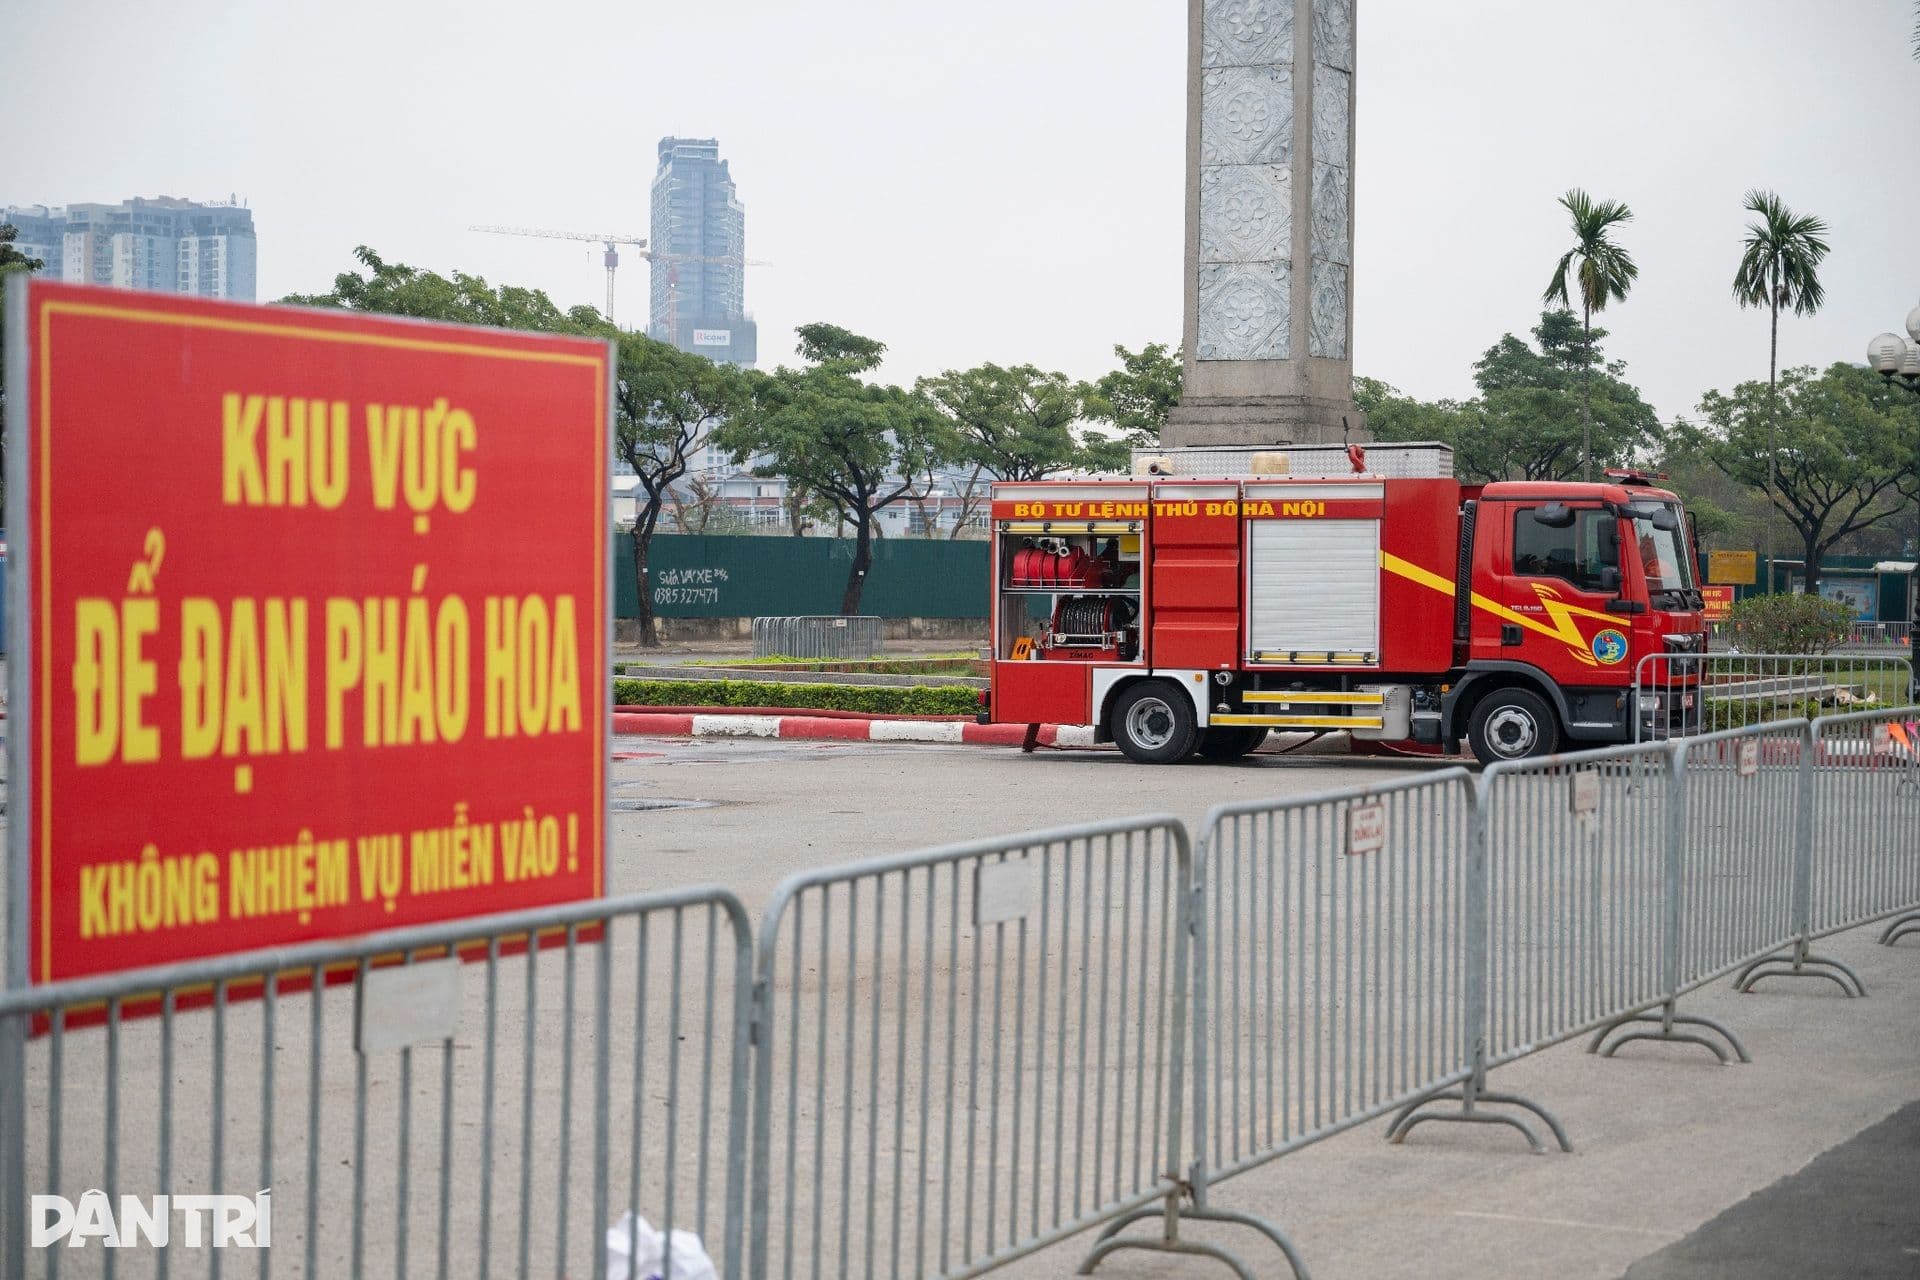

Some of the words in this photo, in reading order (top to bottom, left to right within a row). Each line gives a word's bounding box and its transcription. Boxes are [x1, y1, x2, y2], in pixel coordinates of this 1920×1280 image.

[221, 392, 350, 512] KHU
[364, 396, 479, 535] VỰC
[1014, 501, 1046, 519] BỘ
[1053, 501, 1083, 518] TƯ
[1088, 501, 1149, 519] LỆNH
[1153, 499, 1198, 517] THỦ
[1205, 500, 1238, 517] ĐÔ
[1243, 500, 1275, 517] HÀ
[1282, 500, 1326, 518] NỘI
[696, 568, 713, 584] XE
[72, 527, 166, 766] ĐỂ
[178, 596, 309, 793] ĐẠN
[324, 563, 470, 751] PHÁO
[484, 594, 583, 738] HOA
[79, 843, 220, 939] KHÔNG
[229, 828, 350, 926] NHIỆM
[356, 833, 403, 914] VỤ
[410, 801, 495, 896] MIỄN
[500, 805, 560, 883] VÀO
[566, 812, 580, 874] !
